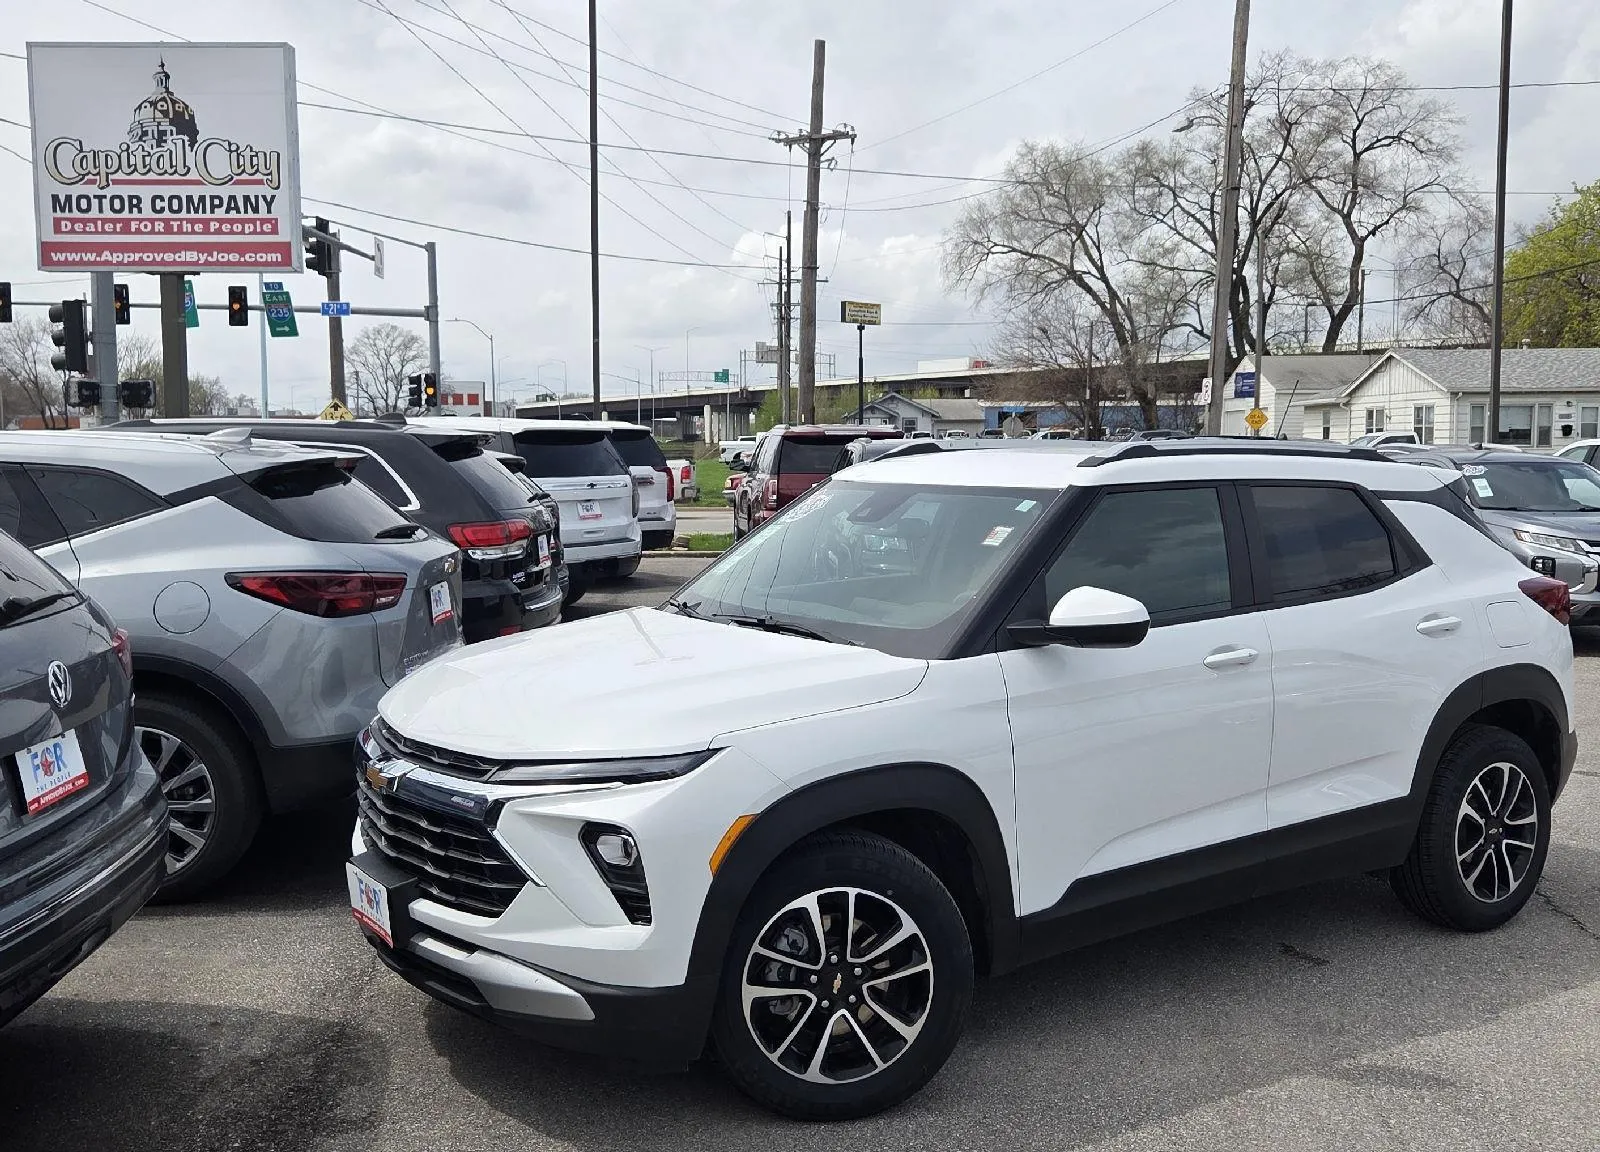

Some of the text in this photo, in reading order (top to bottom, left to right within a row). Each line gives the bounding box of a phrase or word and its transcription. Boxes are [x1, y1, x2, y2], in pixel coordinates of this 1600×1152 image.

[44, 137, 280, 189] Capital City
[51, 194, 277, 214] MOTOR COMPANY
[61, 220, 273, 234] Dealer FOR The People
[50, 250, 282, 263] www.ApprovedByJoe.com
[270, 308, 290, 317] 235
[31, 742, 68, 784] FOR
